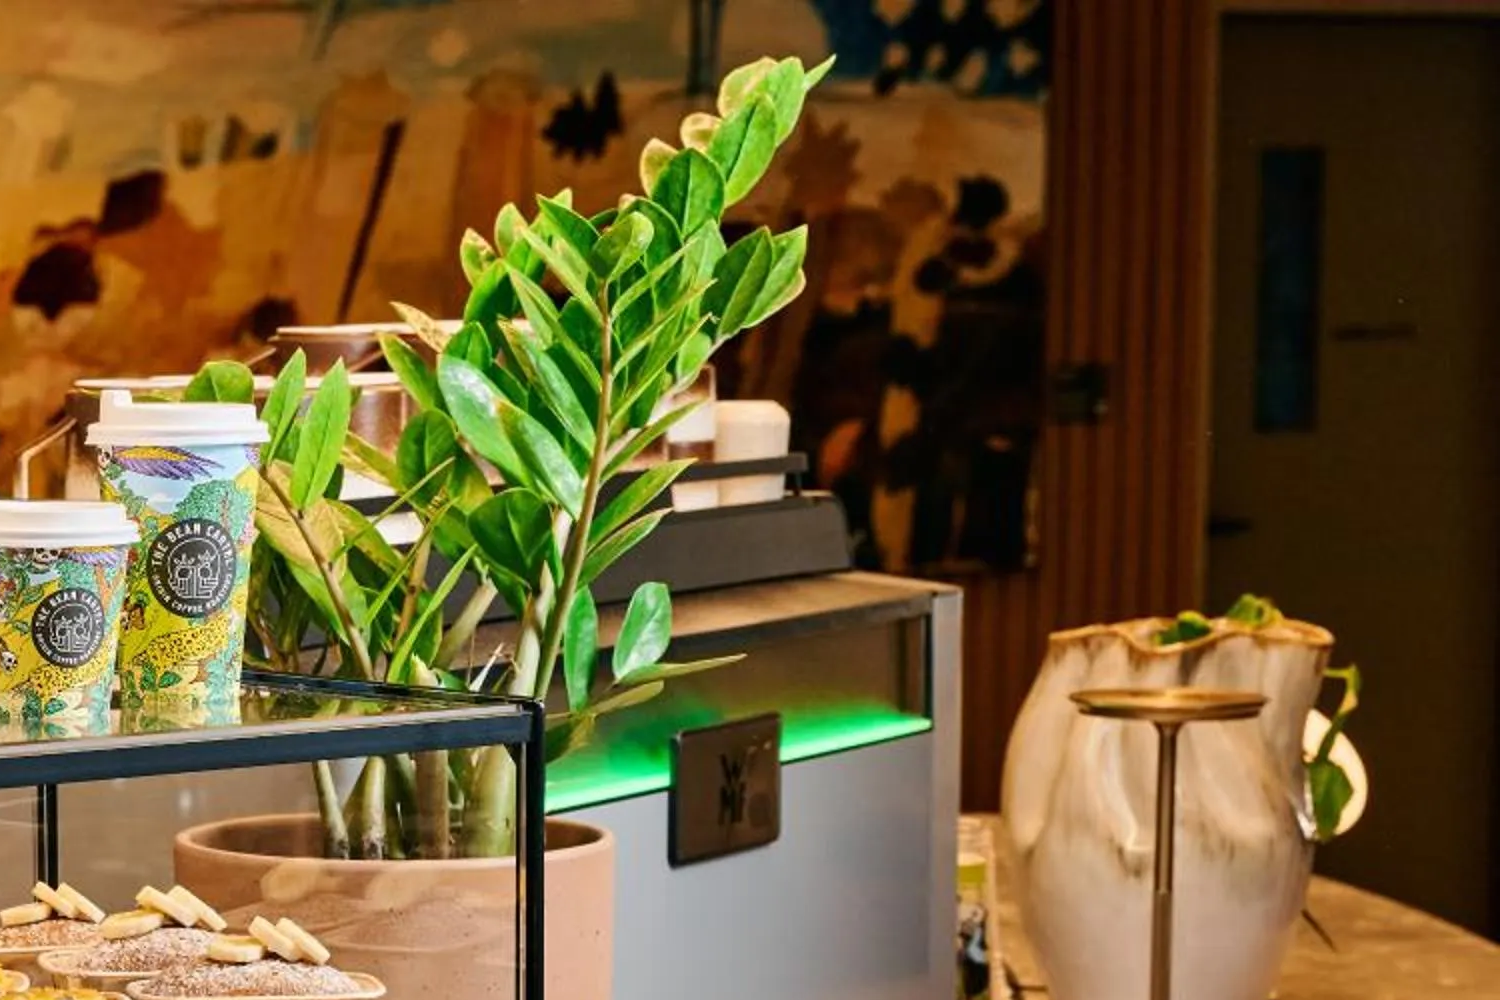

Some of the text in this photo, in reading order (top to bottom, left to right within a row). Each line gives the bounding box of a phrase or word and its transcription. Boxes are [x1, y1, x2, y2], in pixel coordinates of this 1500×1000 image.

[151, 523, 234, 567] THE BEAN CARTEL
[49, 591, 77, 607] BEAN
[171, 599, 203, 613] COFFEE
